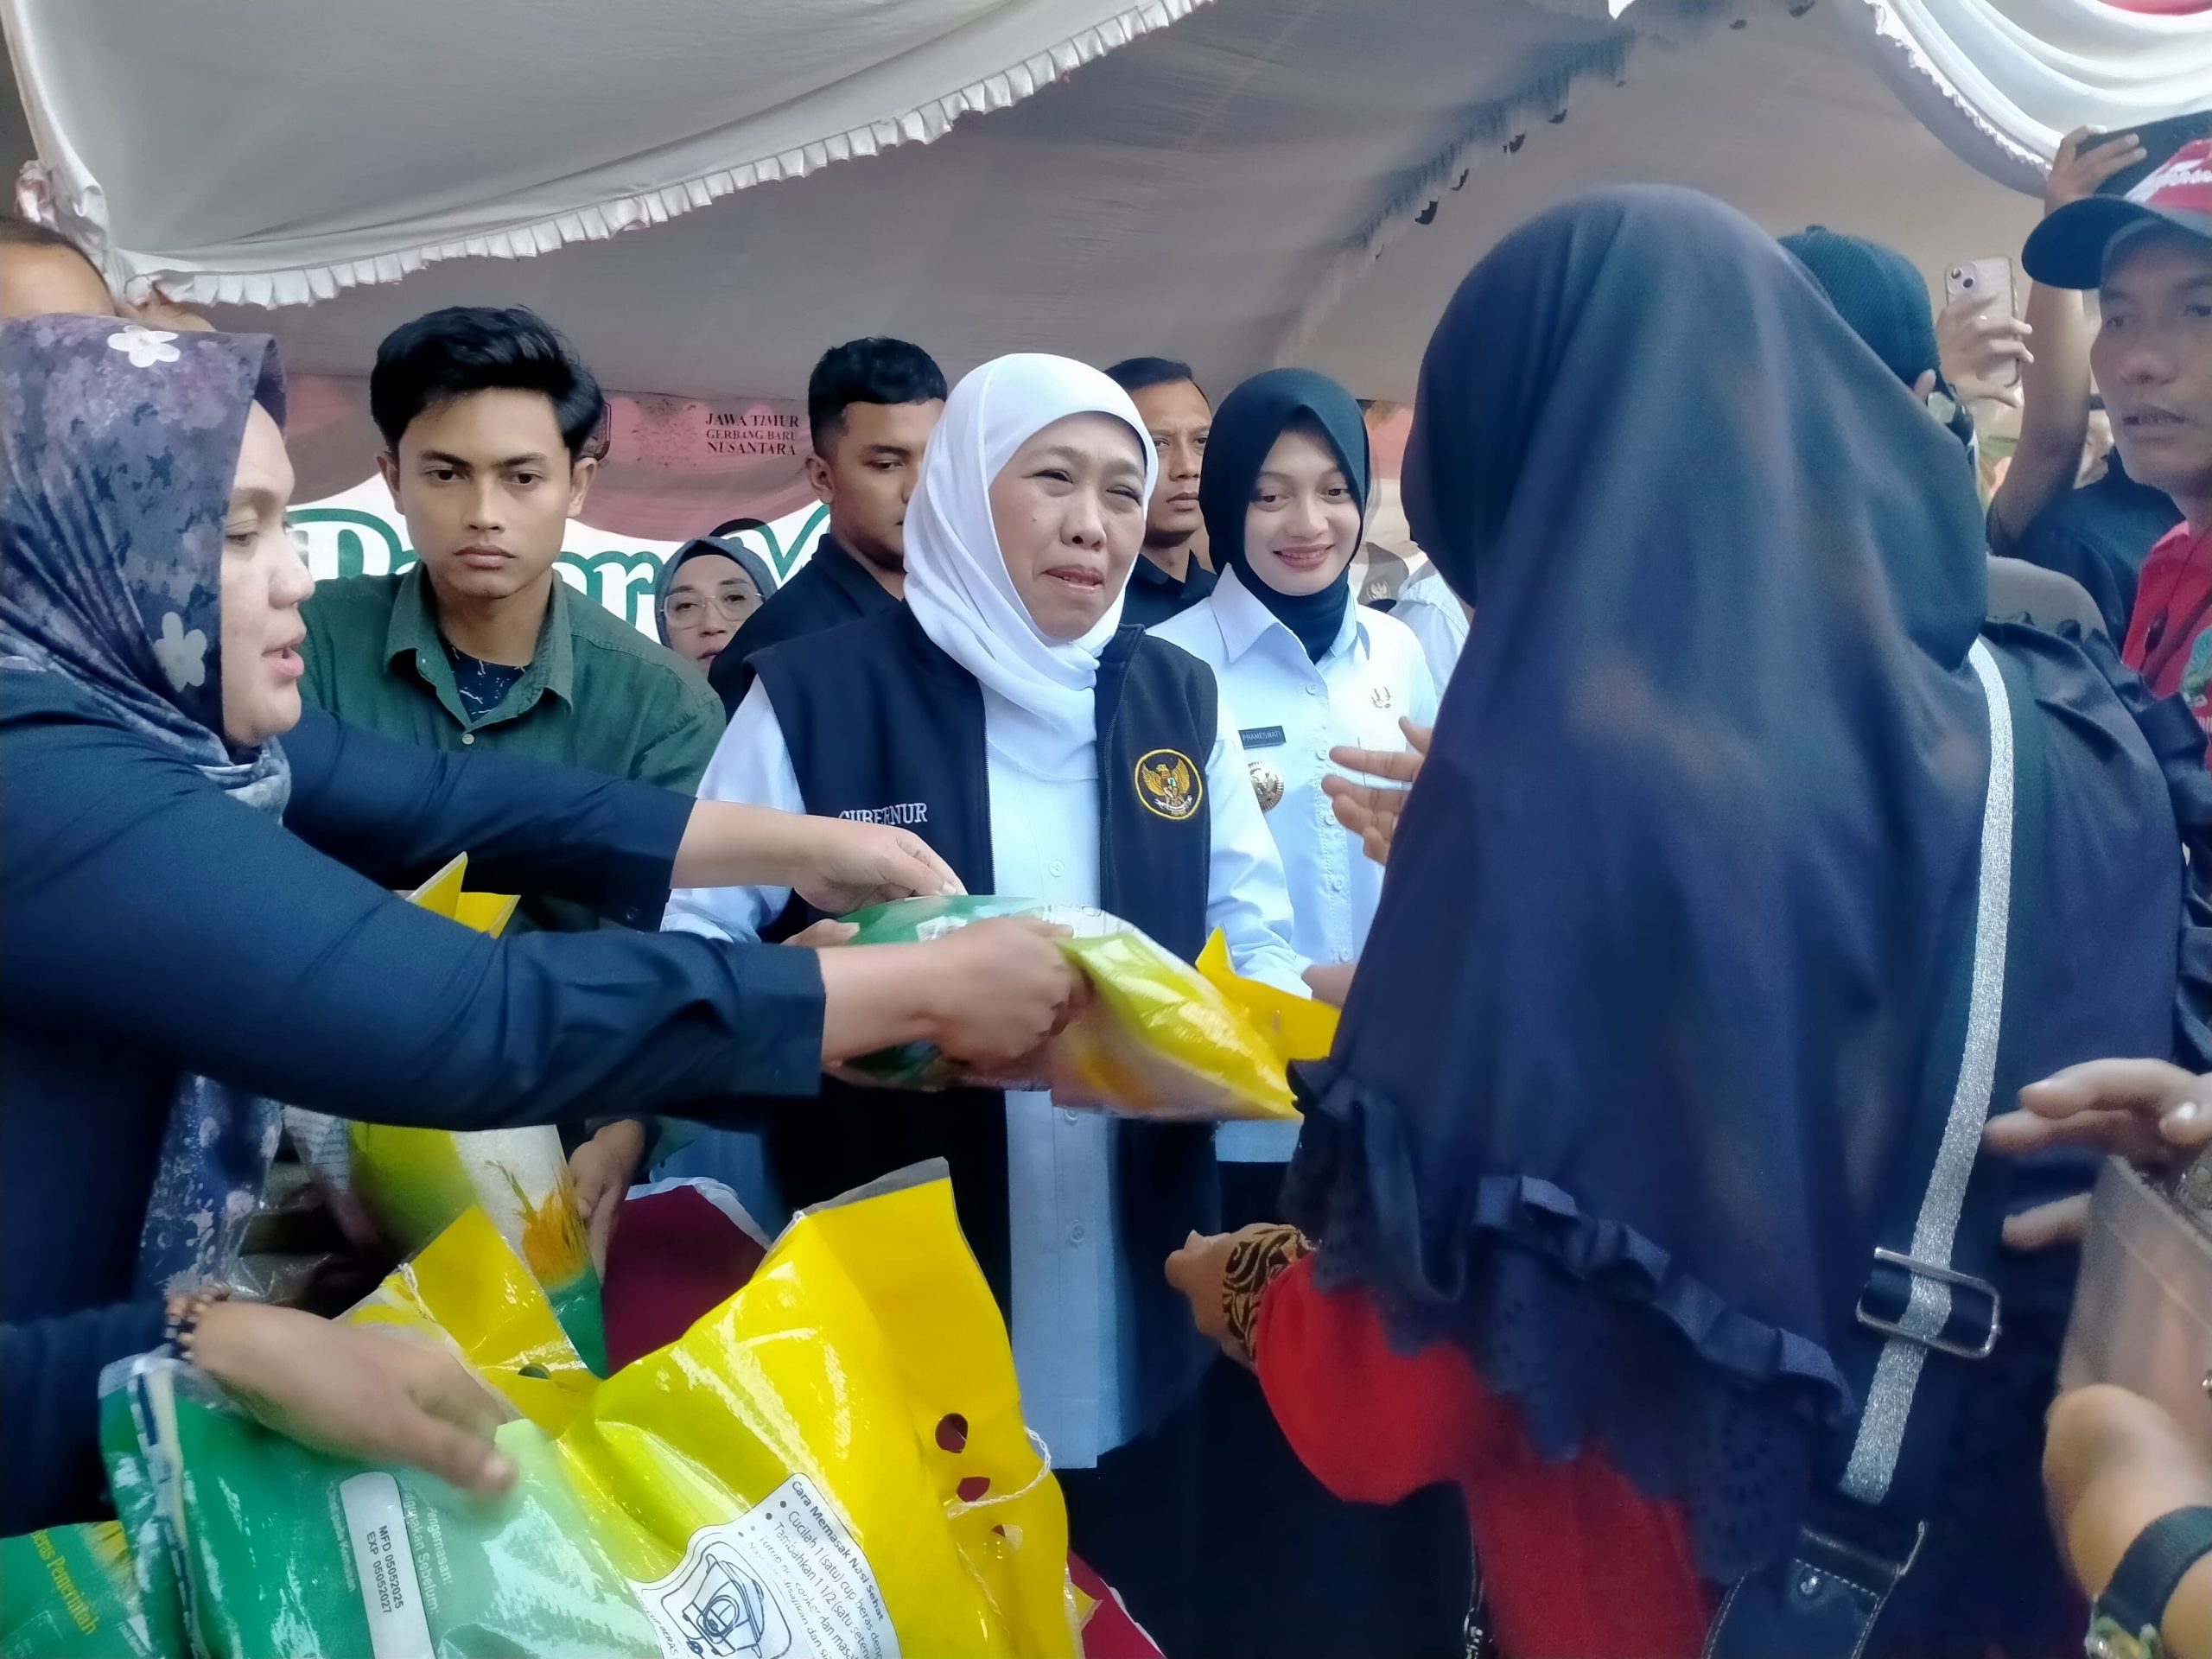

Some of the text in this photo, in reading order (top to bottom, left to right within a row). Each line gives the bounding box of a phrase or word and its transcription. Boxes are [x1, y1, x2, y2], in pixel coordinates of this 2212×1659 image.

[705, 413, 799, 428] JAWA TIMUR
[706, 429, 796, 441] GERBANG BARU
[708, 442, 796, 455] NUSANTARA
[788, 1510, 817, 1549] Cucilah
[378, 1525, 404, 1609] MFD 05052025
[792, 1480, 884, 1622] Cara Memasak Nasi Sehat
[815, 1548, 824, 1556] 1
[818, 1554, 844, 1583] (satu)
[32, 1529, 99, 1636] eras Pemerintah
[366, 1531, 392, 1613] EXP 05052027
[418, 1553, 439, 1615] Sebelum:
[773, 1522, 817, 1581] Tambahkan
[814, 1578, 823, 1587] 1
[821, 1585, 836, 1605] 1/2
[830, 1600, 854, 1627] (satu
[850, 1627, 870, 1659] seten
[840, 1580, 857, 1600] cup
[795, 1582, 821, 1615] cooker
[818, 1616, 835, 1637] dan
[831, 1634, 860, 1659] masa
[855, 1599, 874, 1630] beras
[807, 1627, 822, 1648] dan
